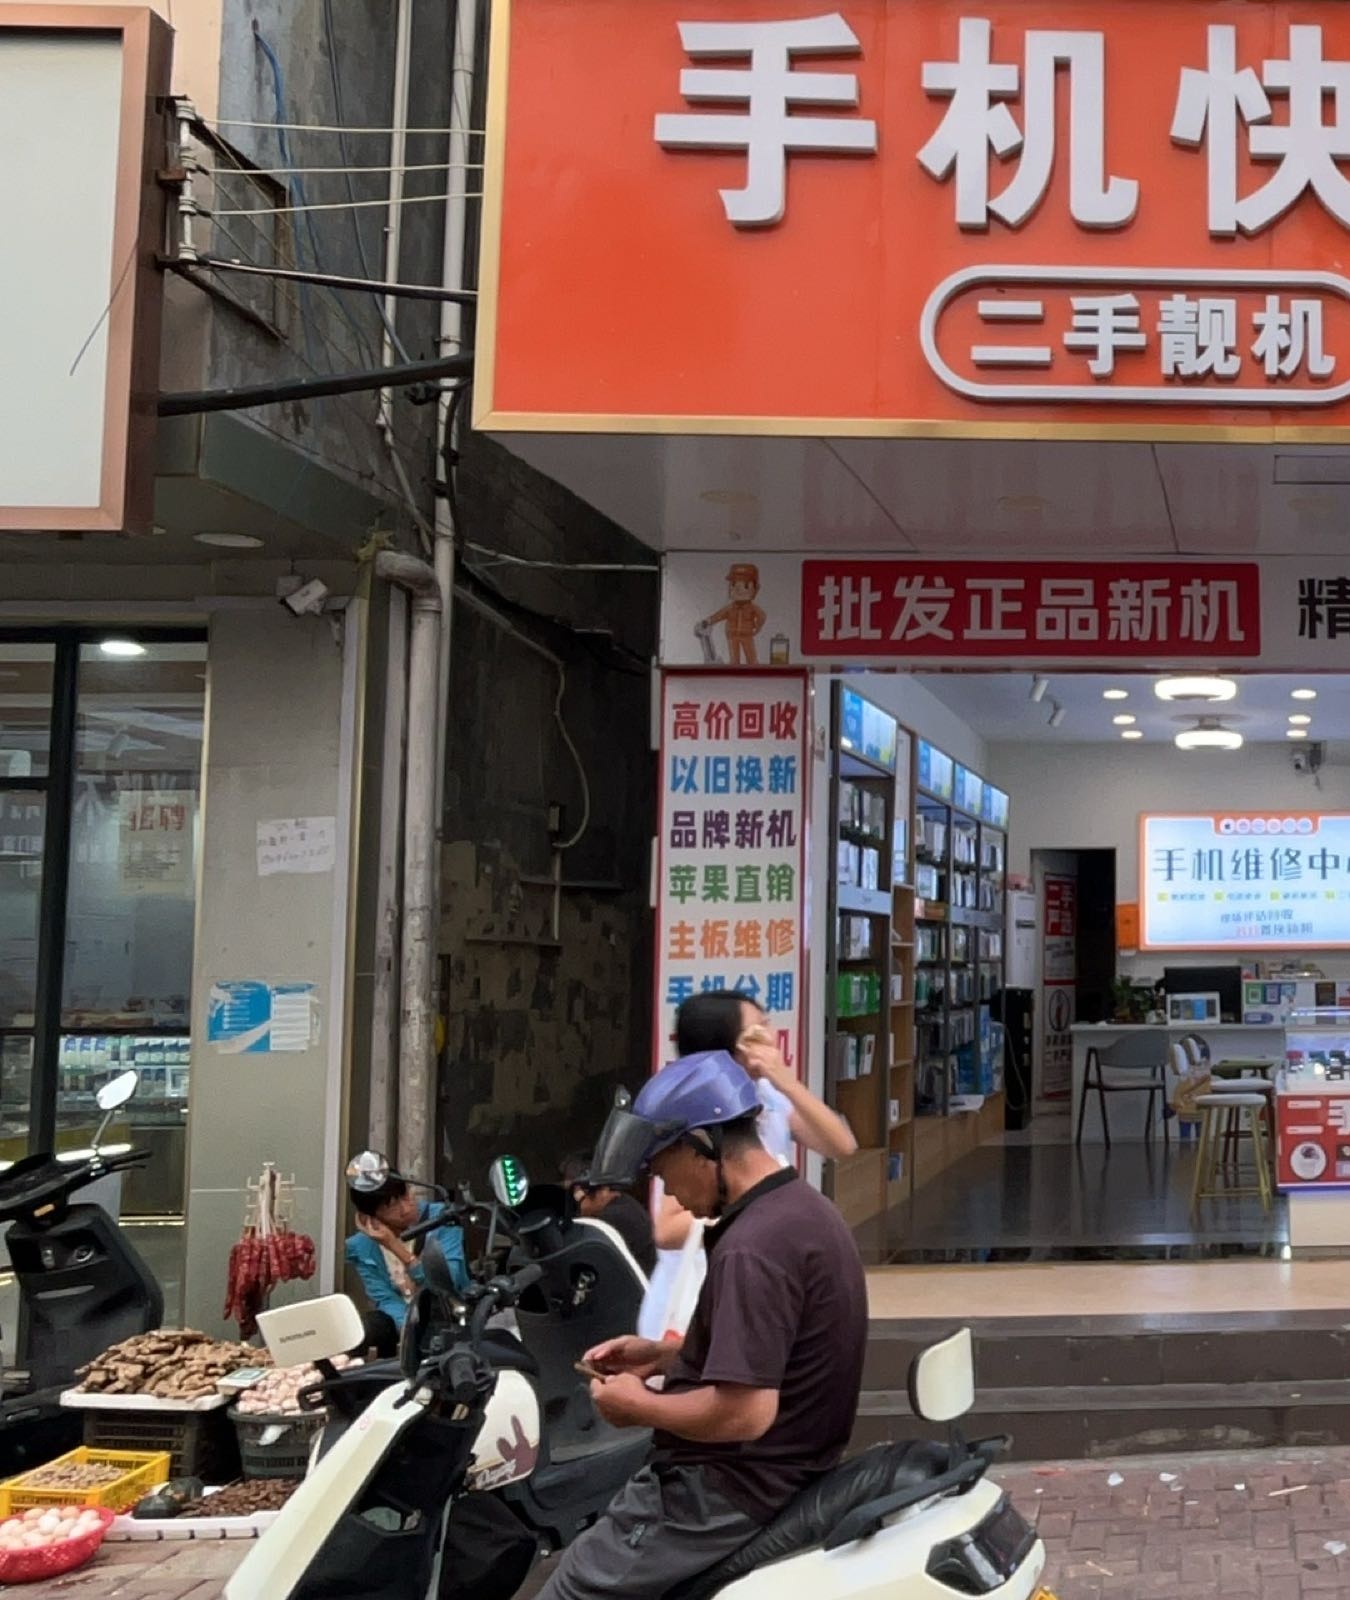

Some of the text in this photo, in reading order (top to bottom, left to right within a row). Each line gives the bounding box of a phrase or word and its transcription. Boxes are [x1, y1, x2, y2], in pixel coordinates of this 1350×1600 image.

[970, 293, 1336, 379] 二手靓机
[817, 574, 1246, 643] 批发正品新机
[671, 701, 798, 741] 高价回收
[670, 755, 797, 795] 以旧换新
[669, 809, 797, 849] 品牌新机
[668, 863, 796, 904] 苹果直销
[667, 918, 796, 961] 主板维修
